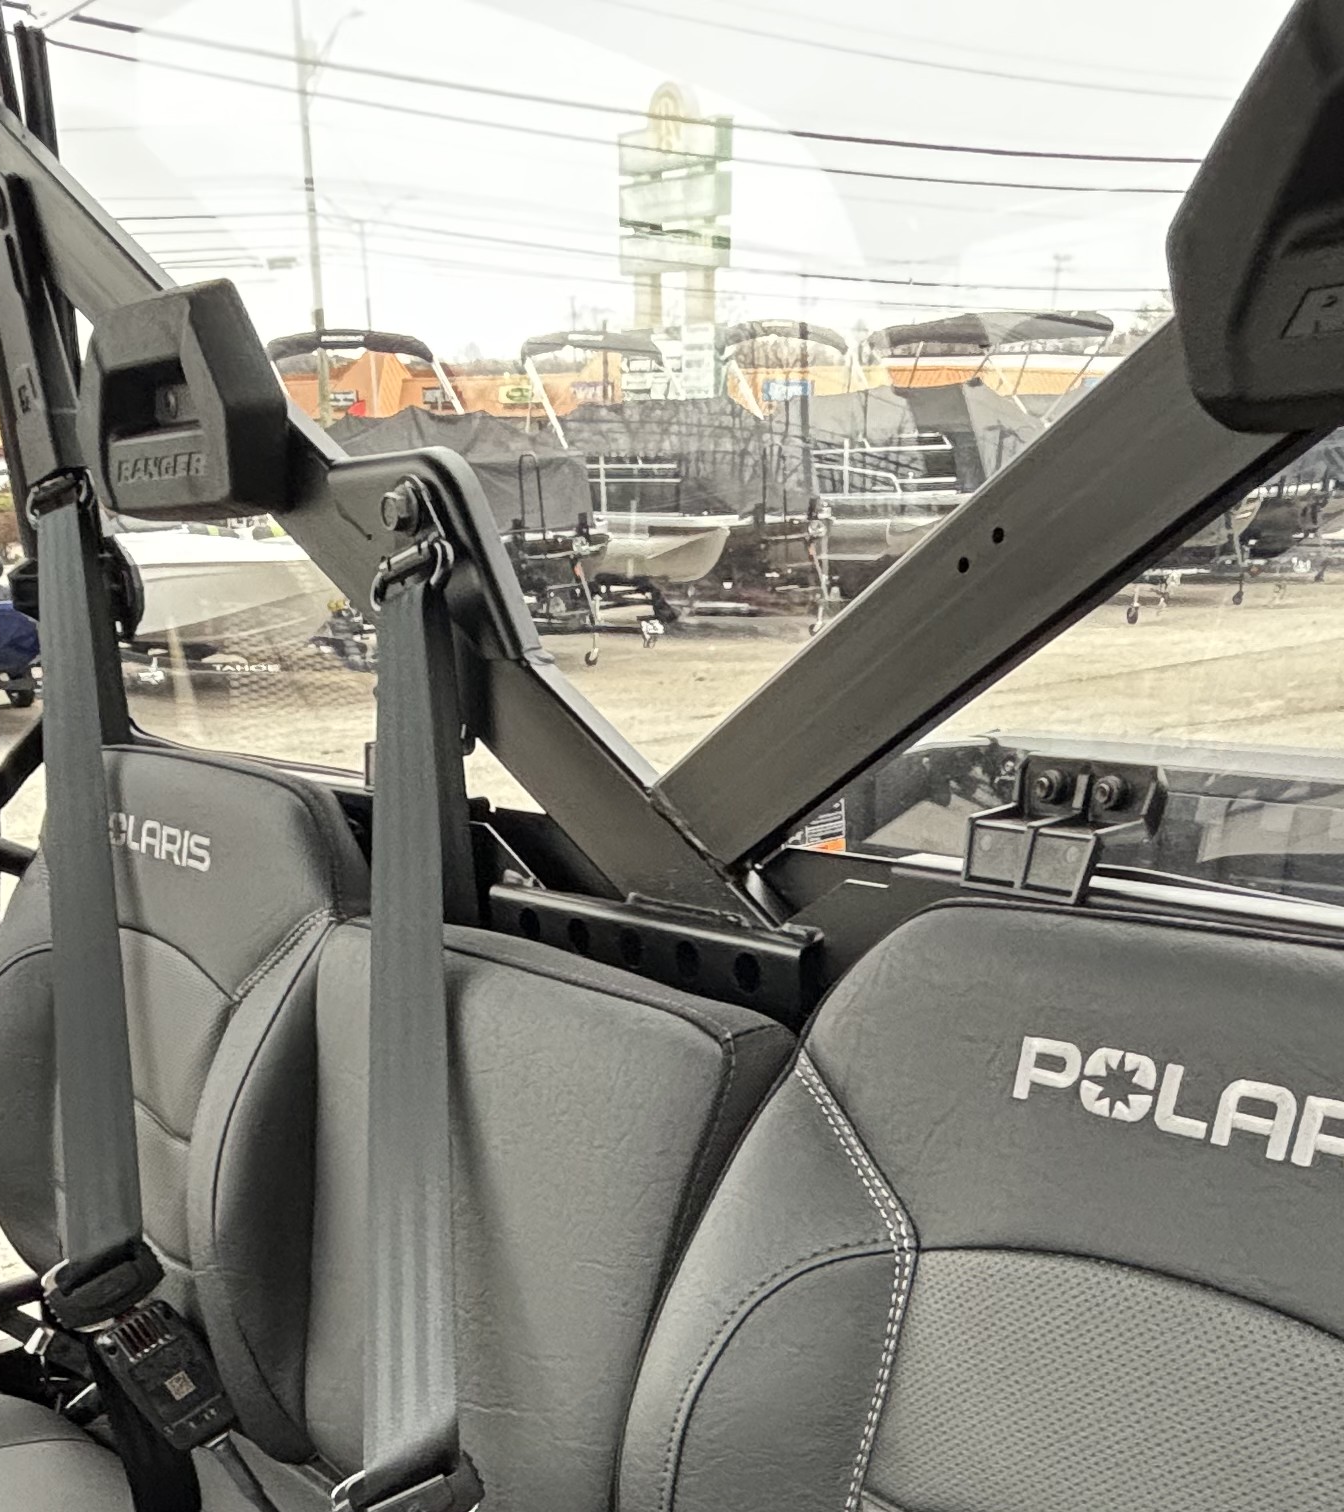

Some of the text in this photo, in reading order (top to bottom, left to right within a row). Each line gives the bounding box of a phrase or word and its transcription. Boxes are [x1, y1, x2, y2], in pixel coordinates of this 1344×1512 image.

[117, 452, 207, 484] RANGER
[212, 663, 281, 672] TAHOE
[108, 812, 211, 872] OLARIS
